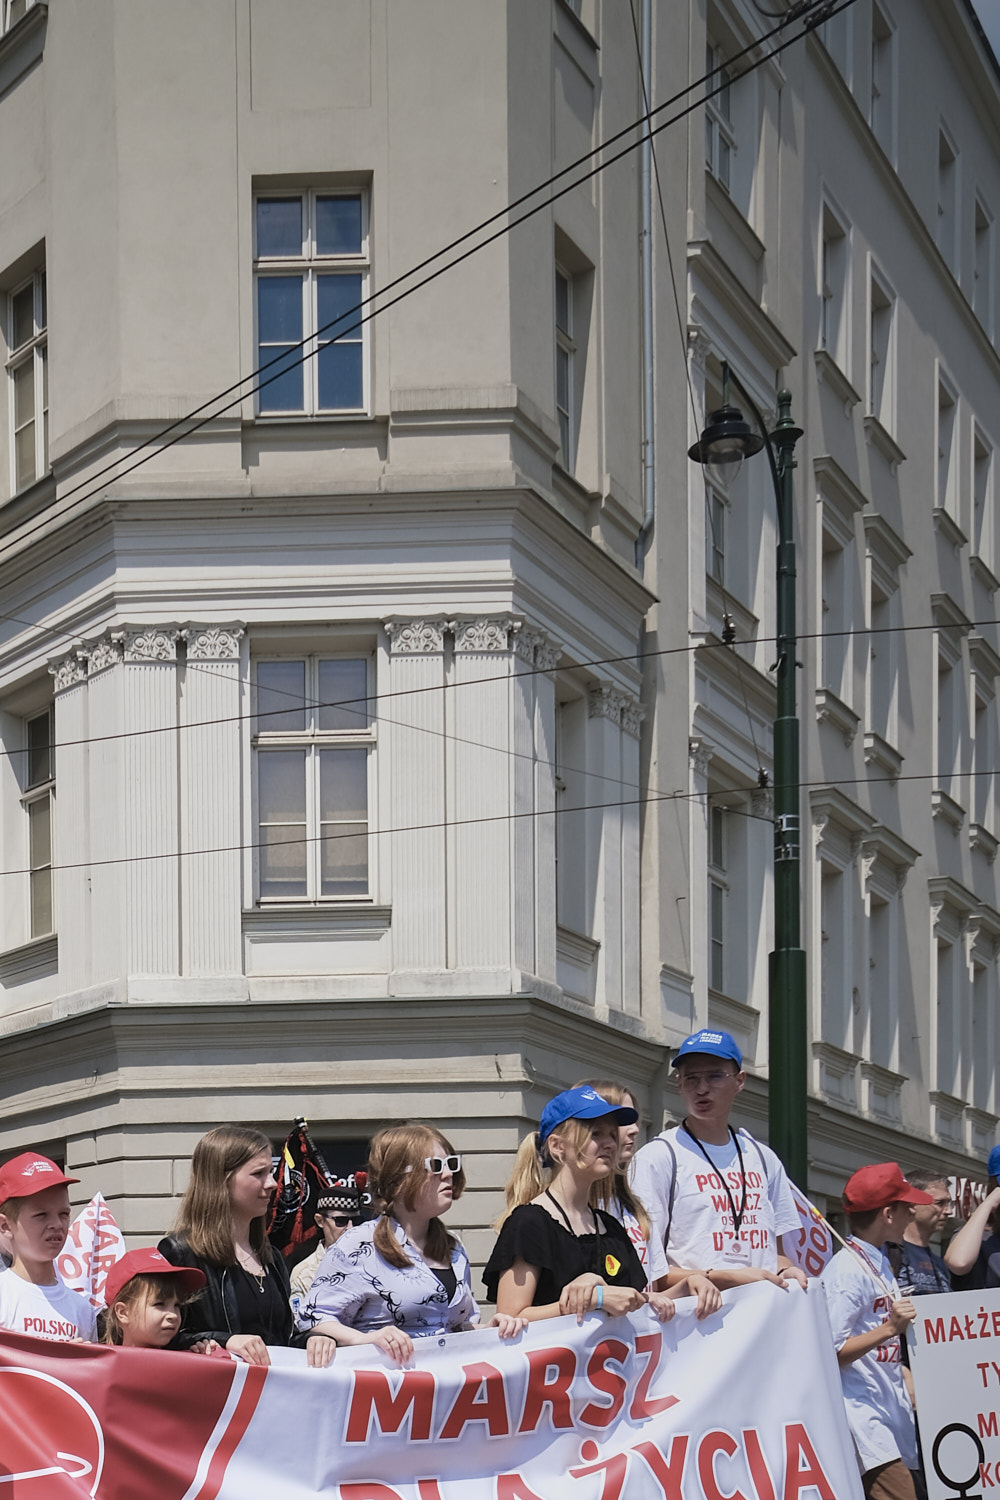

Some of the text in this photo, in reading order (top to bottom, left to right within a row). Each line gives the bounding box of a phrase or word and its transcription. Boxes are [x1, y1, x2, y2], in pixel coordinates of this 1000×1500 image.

[695, 1172, 764, 1192] POSKO!
[728, 1214, 758, 1225] SOJE
[23, 1317, 77, 1339] POLSKO!
[344, 1333, 681, 1443] MARSZ
